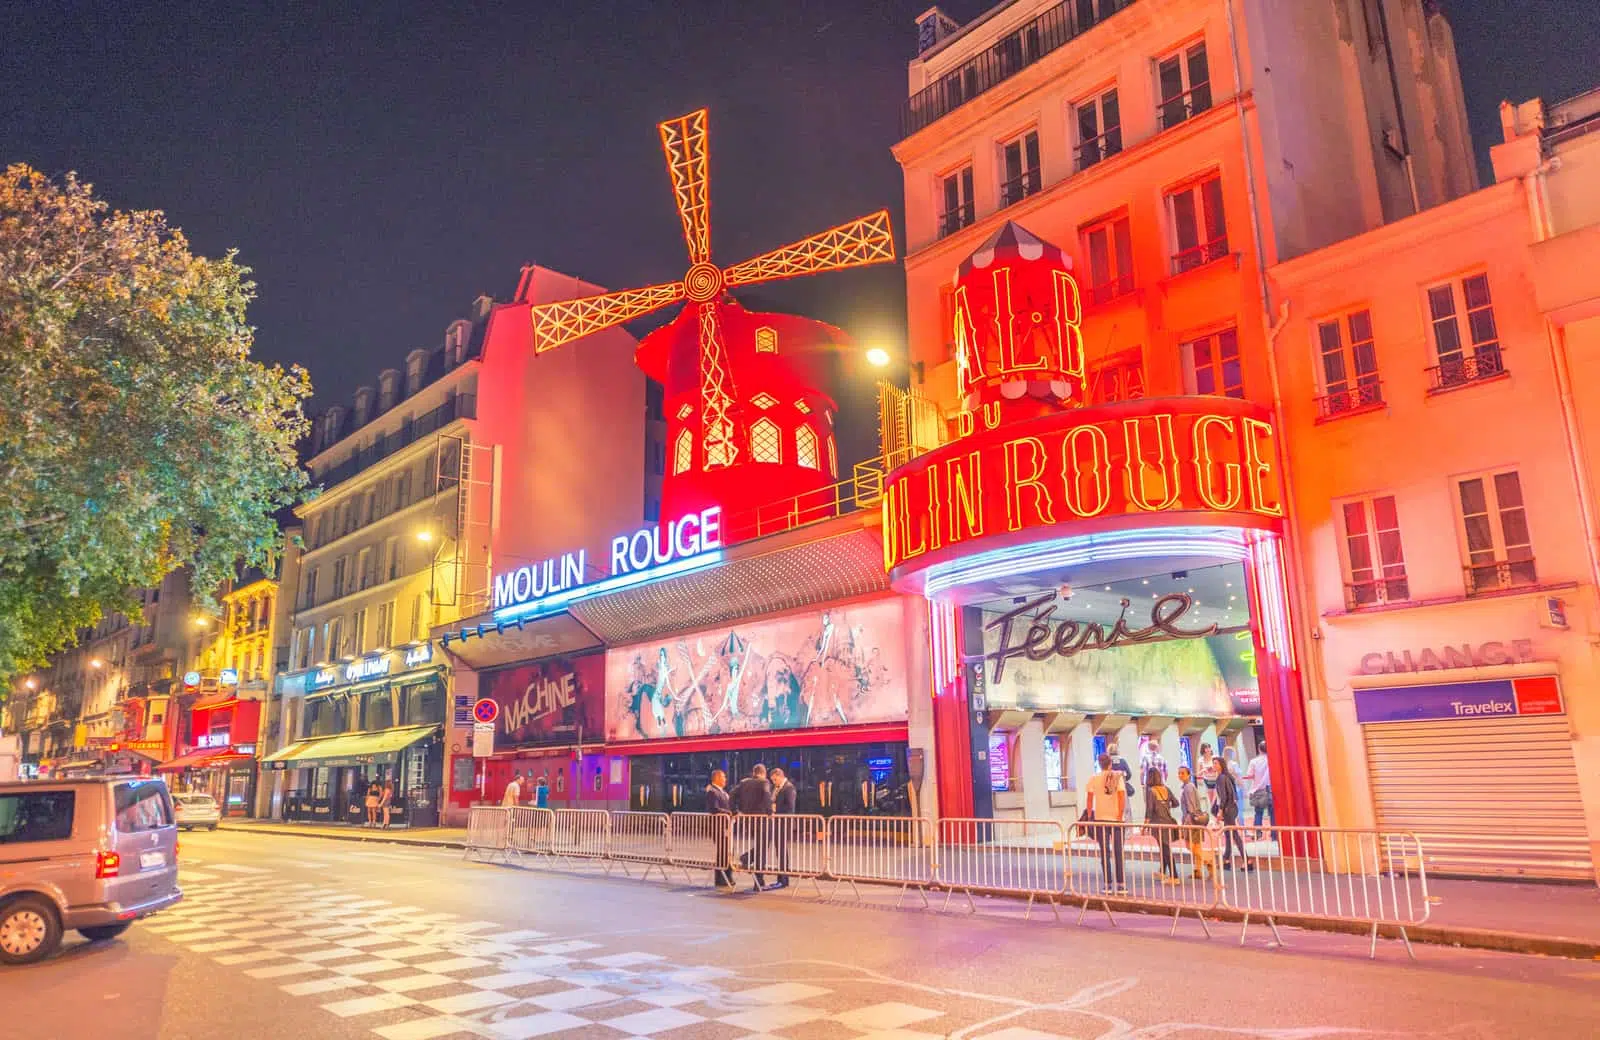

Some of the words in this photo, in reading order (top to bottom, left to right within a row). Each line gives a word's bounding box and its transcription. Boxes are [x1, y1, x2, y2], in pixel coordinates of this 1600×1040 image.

[958, 400, 1001, 438] DU
[1003, 413, 1283, 532] ROUGE
[494, 548, 586, 607] MOULIN
[611, 505, 722, 576] ROUGE
[1360, 638, 1533, 675] CHANGE
[503, 672, 577, 735] MACHINE
[1450, 700, 1513, 715] Travelex
